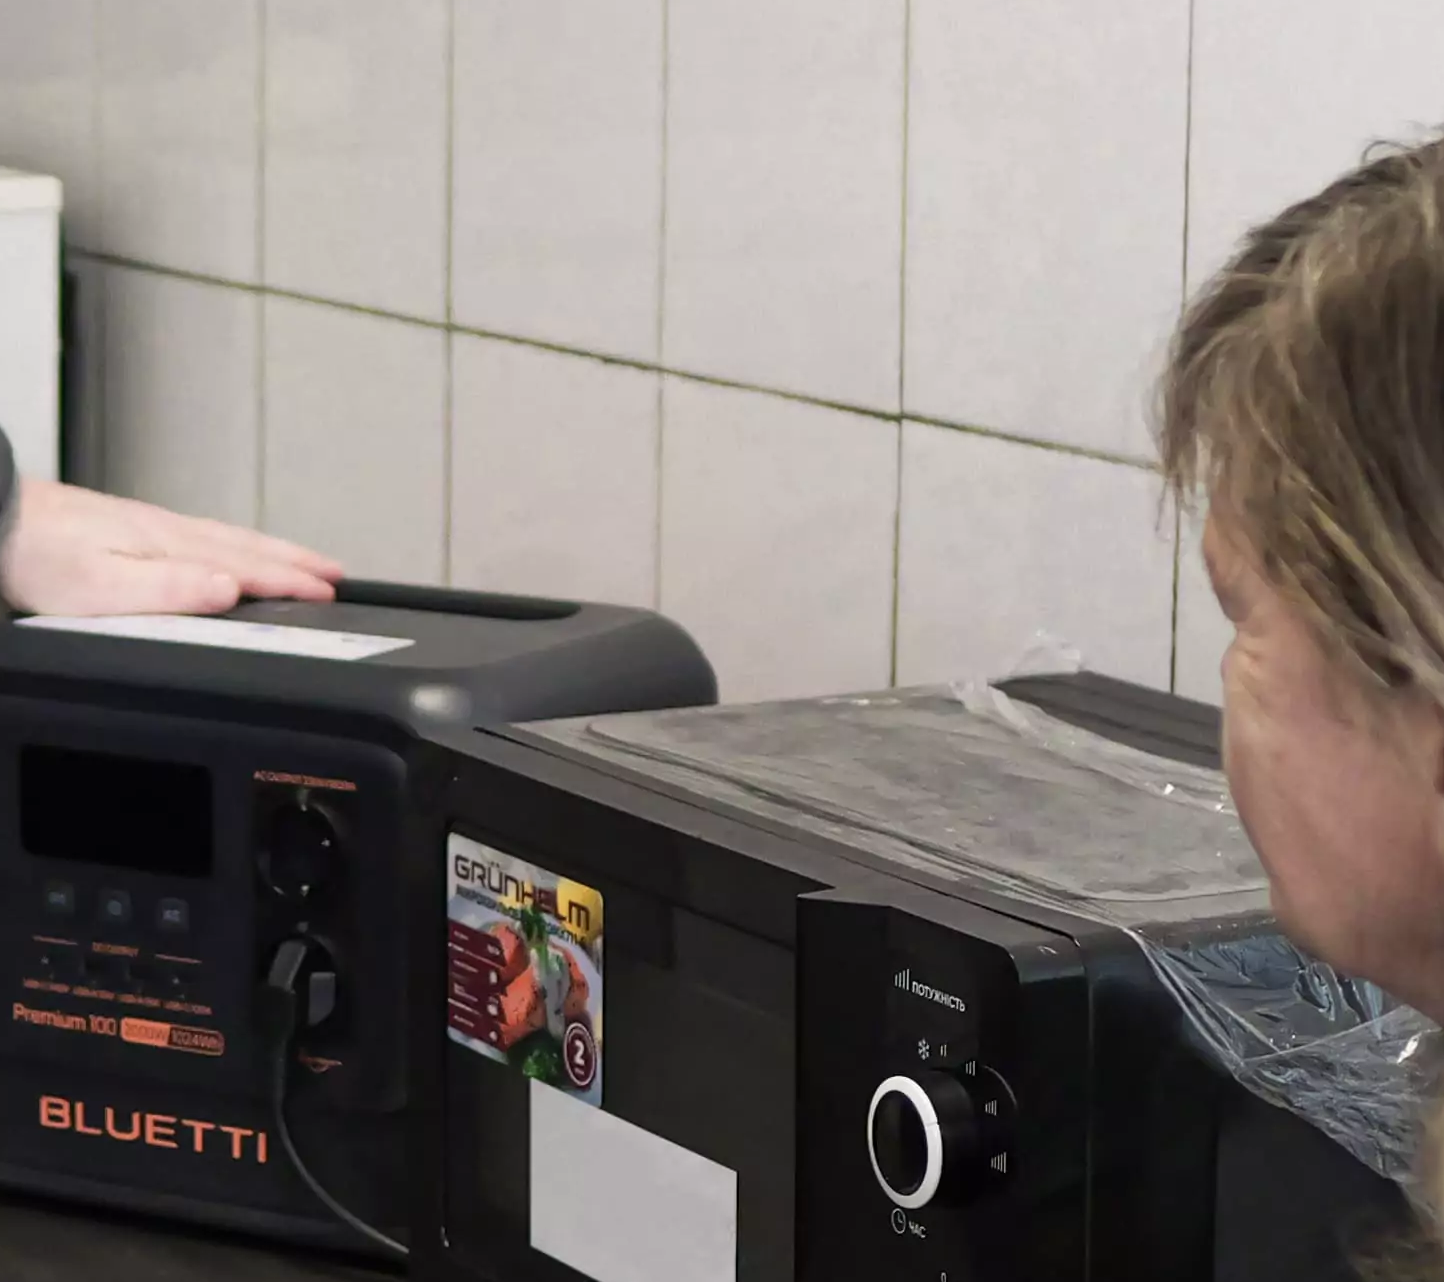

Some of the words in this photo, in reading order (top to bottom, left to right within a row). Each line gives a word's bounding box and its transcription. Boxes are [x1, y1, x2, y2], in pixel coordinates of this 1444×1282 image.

[455, 854, 590, 931] GRÜNHELM
[912, 981, 965, 1012] ПОТУЖНІСТЬ
[13, 1002, 86, 1031] Premium
[89, 1014, 117, 1036] 100
[573, 1039, 585, 1066] 2
[39, 1095, 267, 1163] BLUETTI
